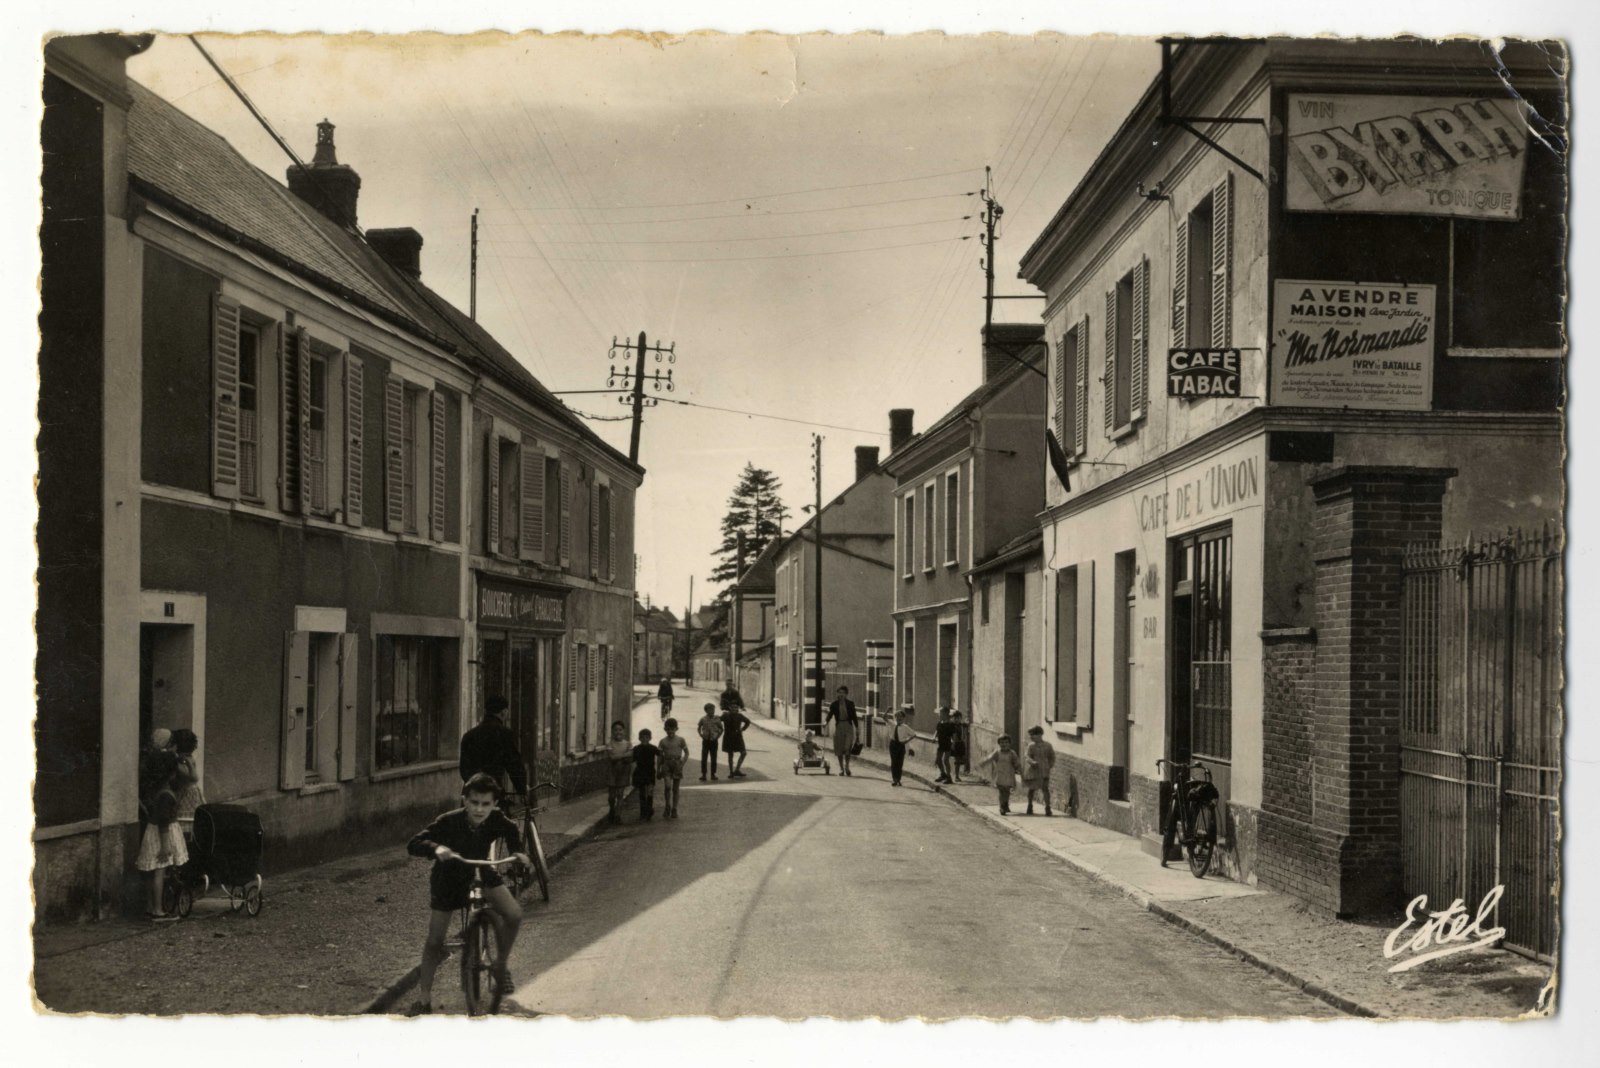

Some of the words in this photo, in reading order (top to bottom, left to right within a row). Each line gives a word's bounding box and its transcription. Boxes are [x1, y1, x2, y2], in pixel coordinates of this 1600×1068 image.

[1298, 100, 1334, 118] VIN
[1290, 99, 1526, 207] BYRRH
[1425, 188, 1512, 211] TONIQUE
[1298, 288, 1316, 302] A
[1321, 289, 1419, 306] VENDRE
[1290, 304, 1367, 318] MAISON
[1170, 350, 1237, 371] CAFÉ
[1352, 360, 1375, 370] IVRY
[1382, 361, 1422, 371] BATAILLE
[1170, 375, 1236, 395] TABAC
[1176, 483, 1192, 522] DE
[1143, 616, 1158, 639] BAR
